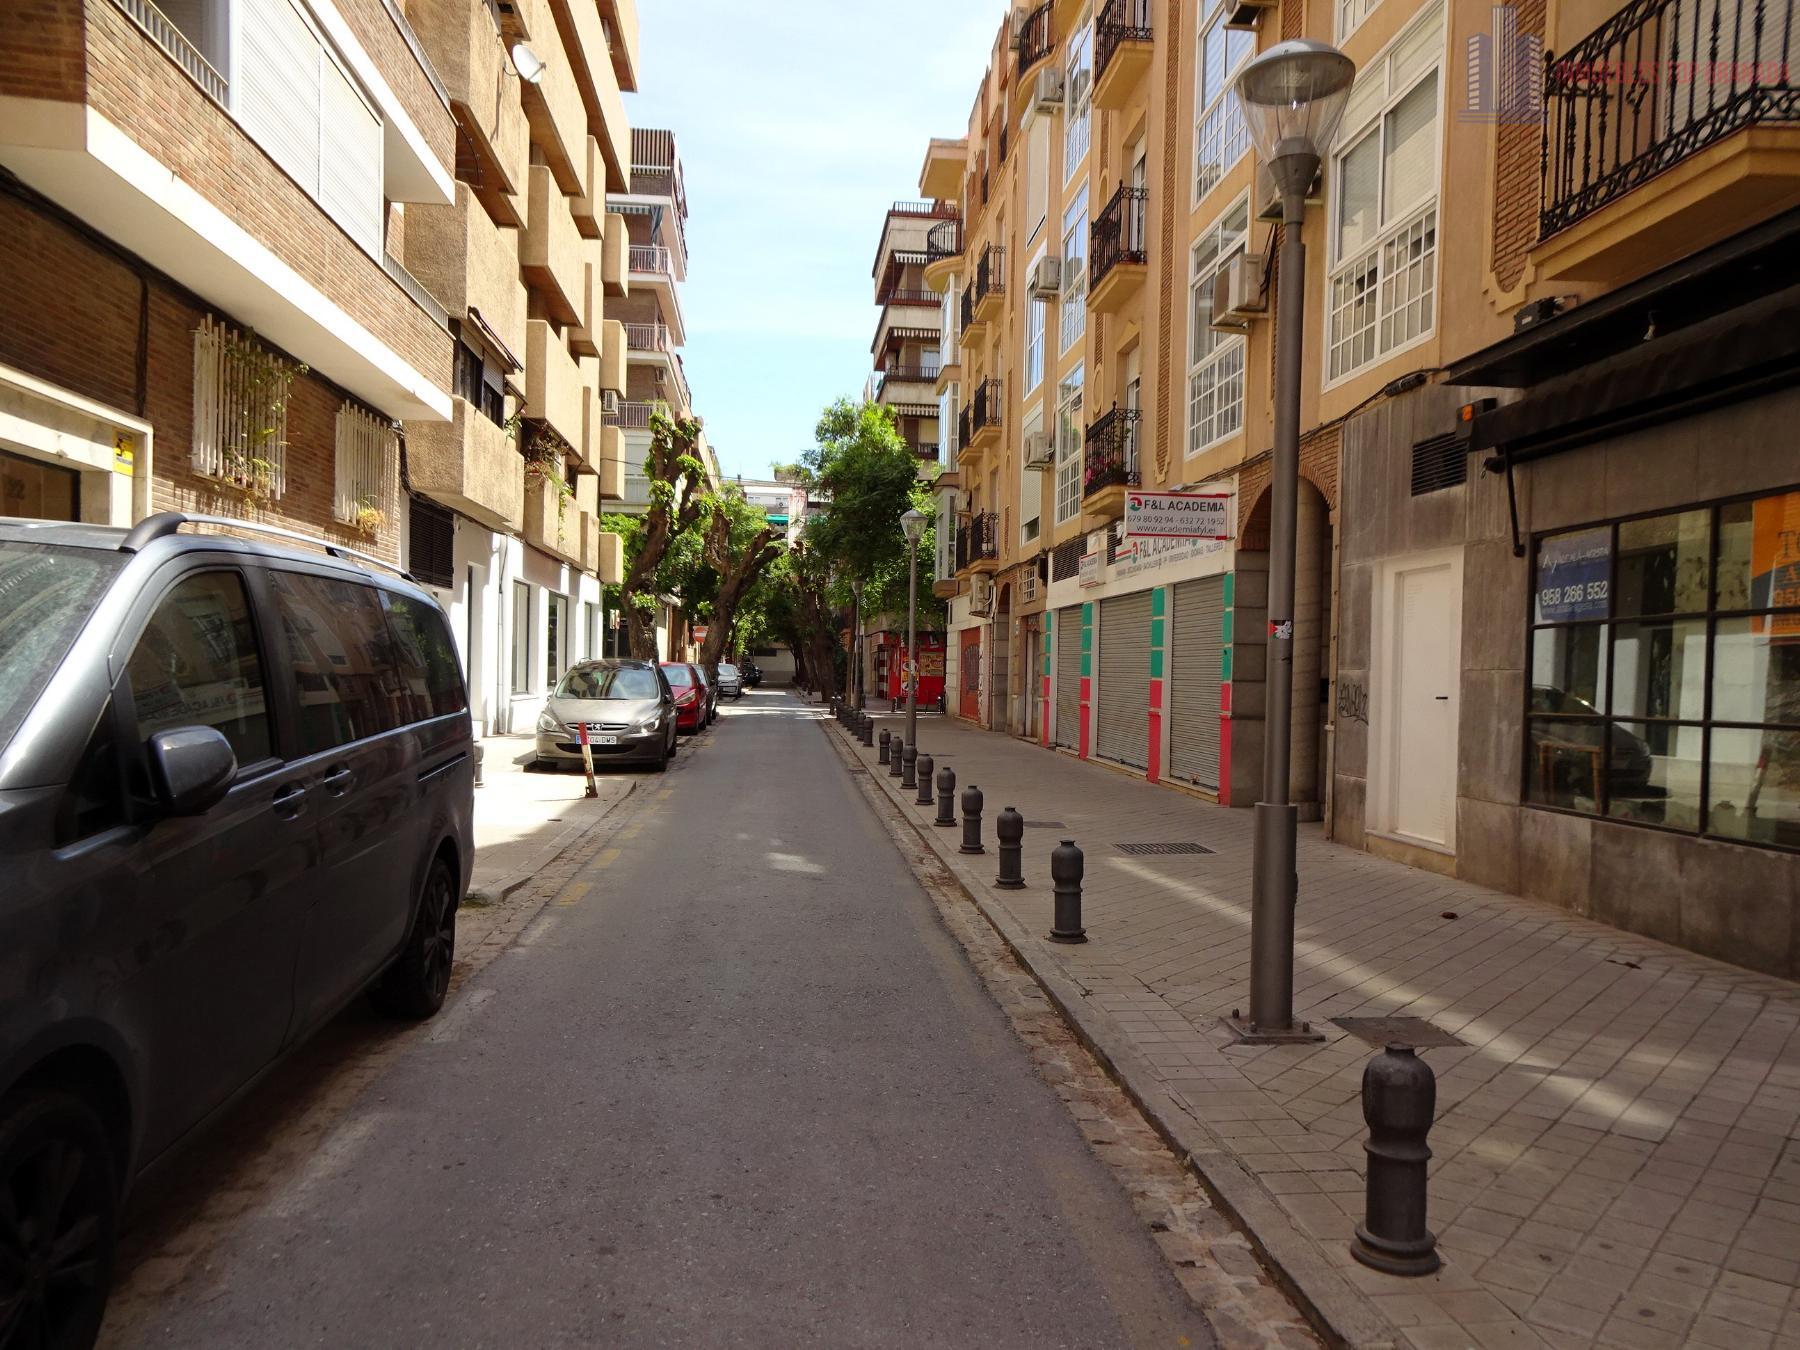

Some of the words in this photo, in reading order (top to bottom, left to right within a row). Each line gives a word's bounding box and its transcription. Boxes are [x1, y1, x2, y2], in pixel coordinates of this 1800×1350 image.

[1144, 499, 1165, 510] F&L
[1167, 501, 1225, 512] ACADEMIA
[1143, 515, 1153, 523] 80
[1180, 517, 1193, 525] 632
[1542, 588, 1561, 606] 958
[1587, 581, 1608, 600] 552
